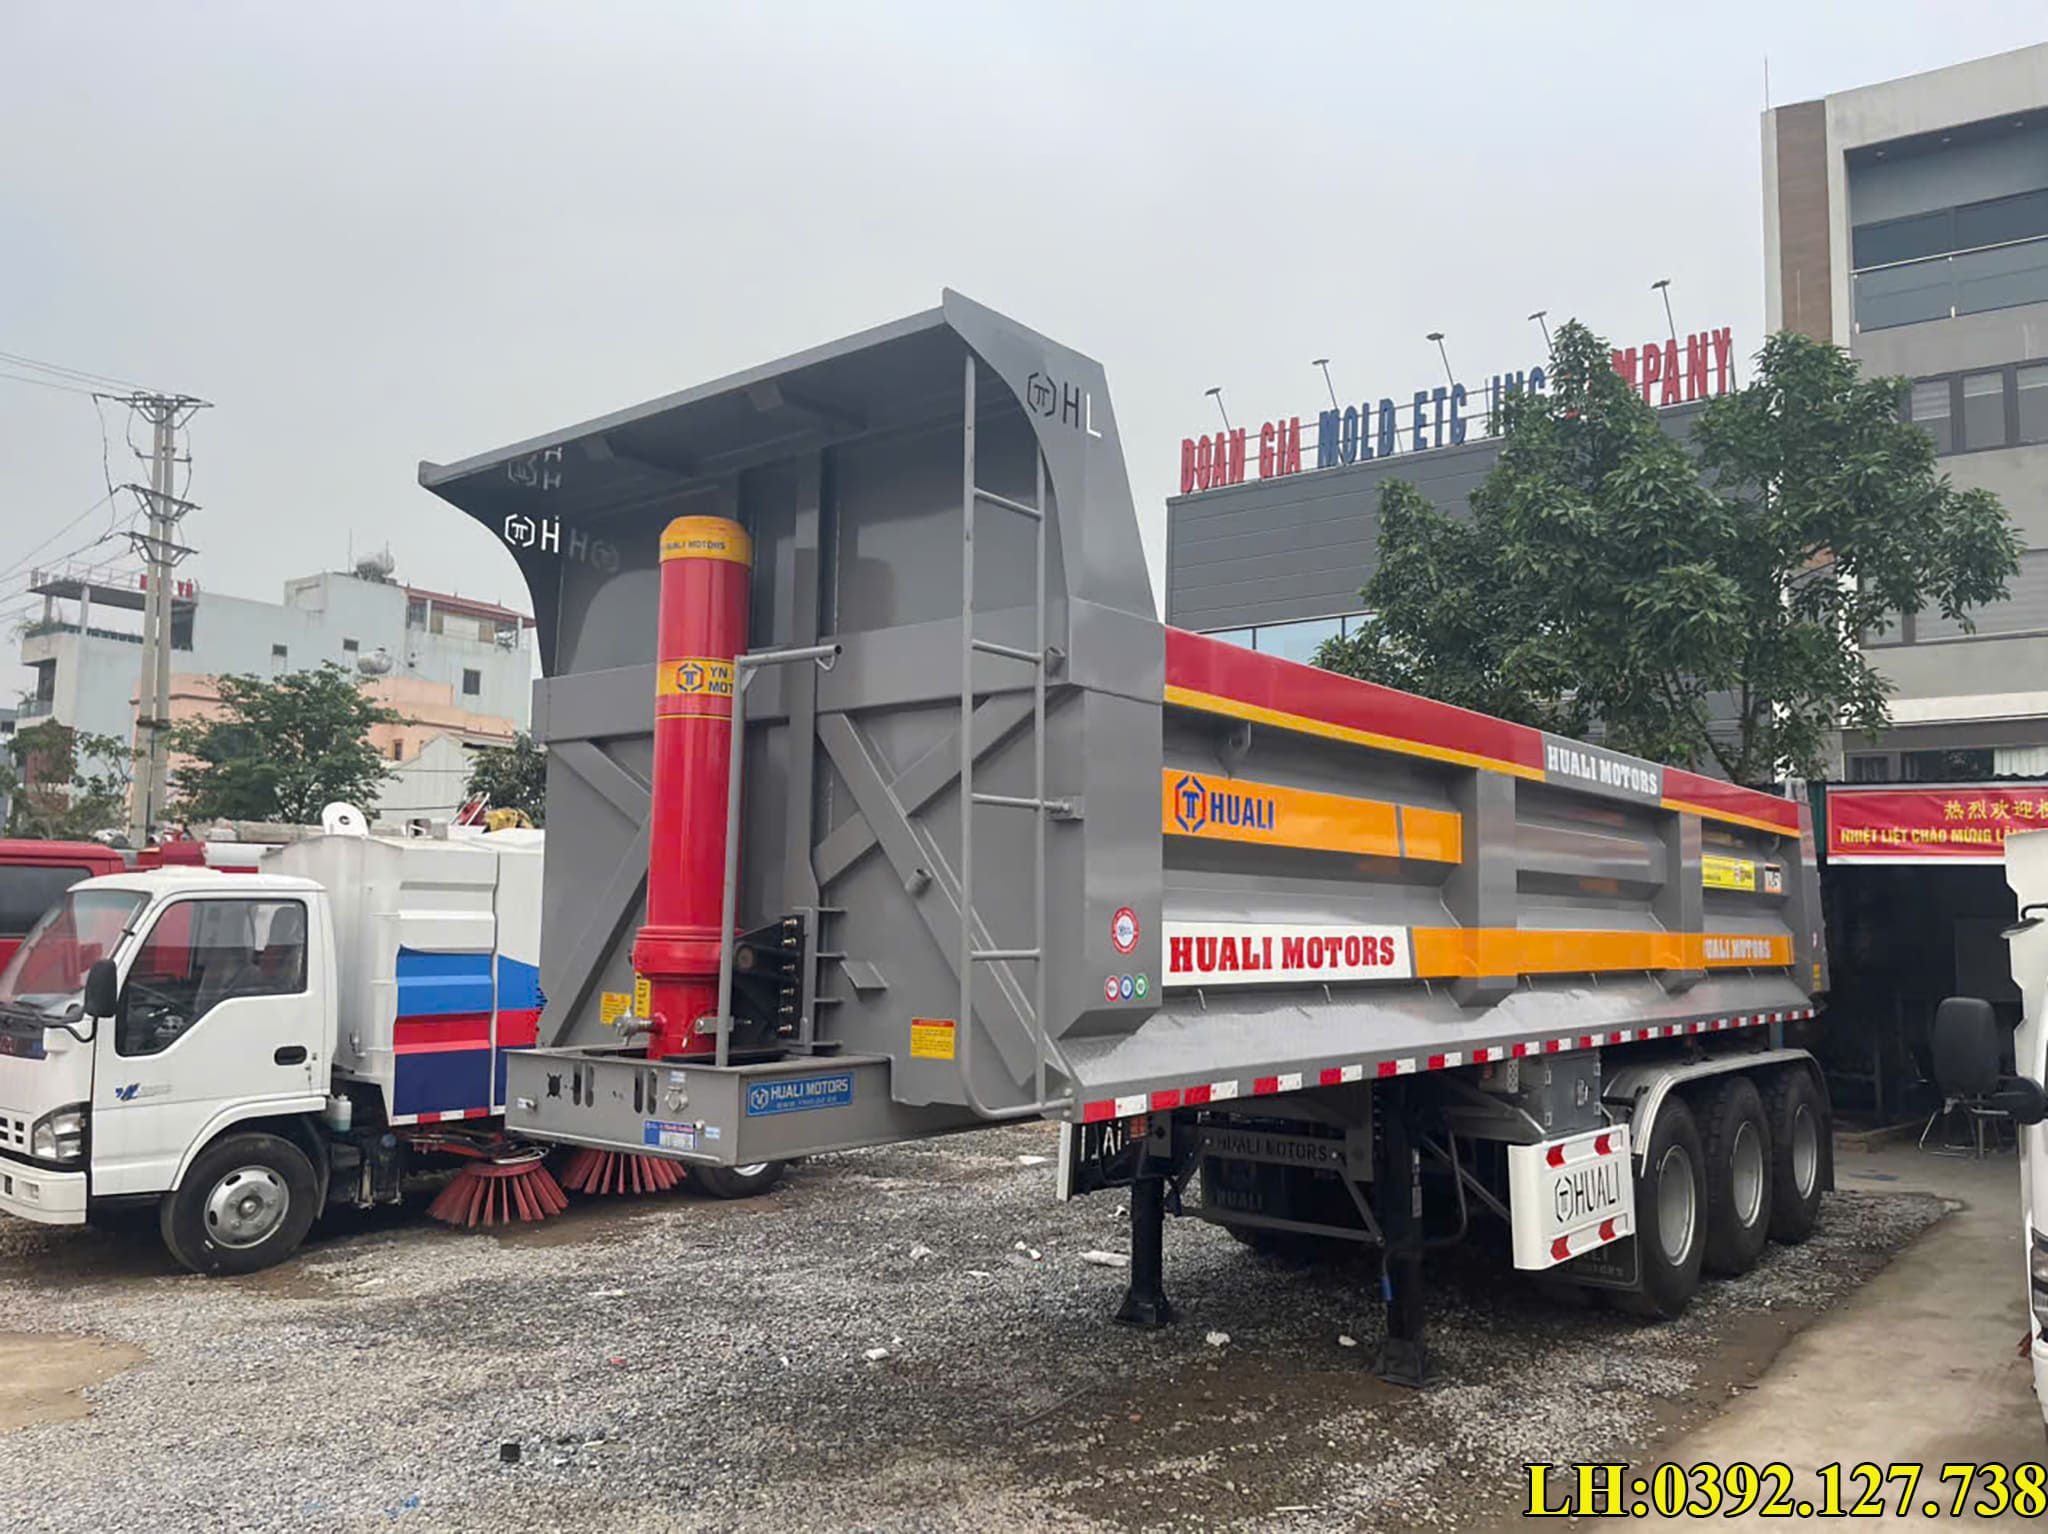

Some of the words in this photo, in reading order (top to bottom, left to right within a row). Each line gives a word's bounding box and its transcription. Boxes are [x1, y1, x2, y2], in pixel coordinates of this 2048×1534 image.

[1259, 416, 1300, 478] GIA
[1317, 398, 1395, 468] MOLD
[1546, 744, 1597, 781] HUALI
[1600, 758, 1658, 796] MOTORS
[1210, 791, 1275, 830] HUALI
[1169, 936, 1273, 974] HUALI
[1281, 935, 1395, 970] MOTORS
[771, 1085, 803, 1101] HUALI
[806, 1078, 848, 1096] MOTORS
[1573, 1161, 1620, 1216] HUALI
